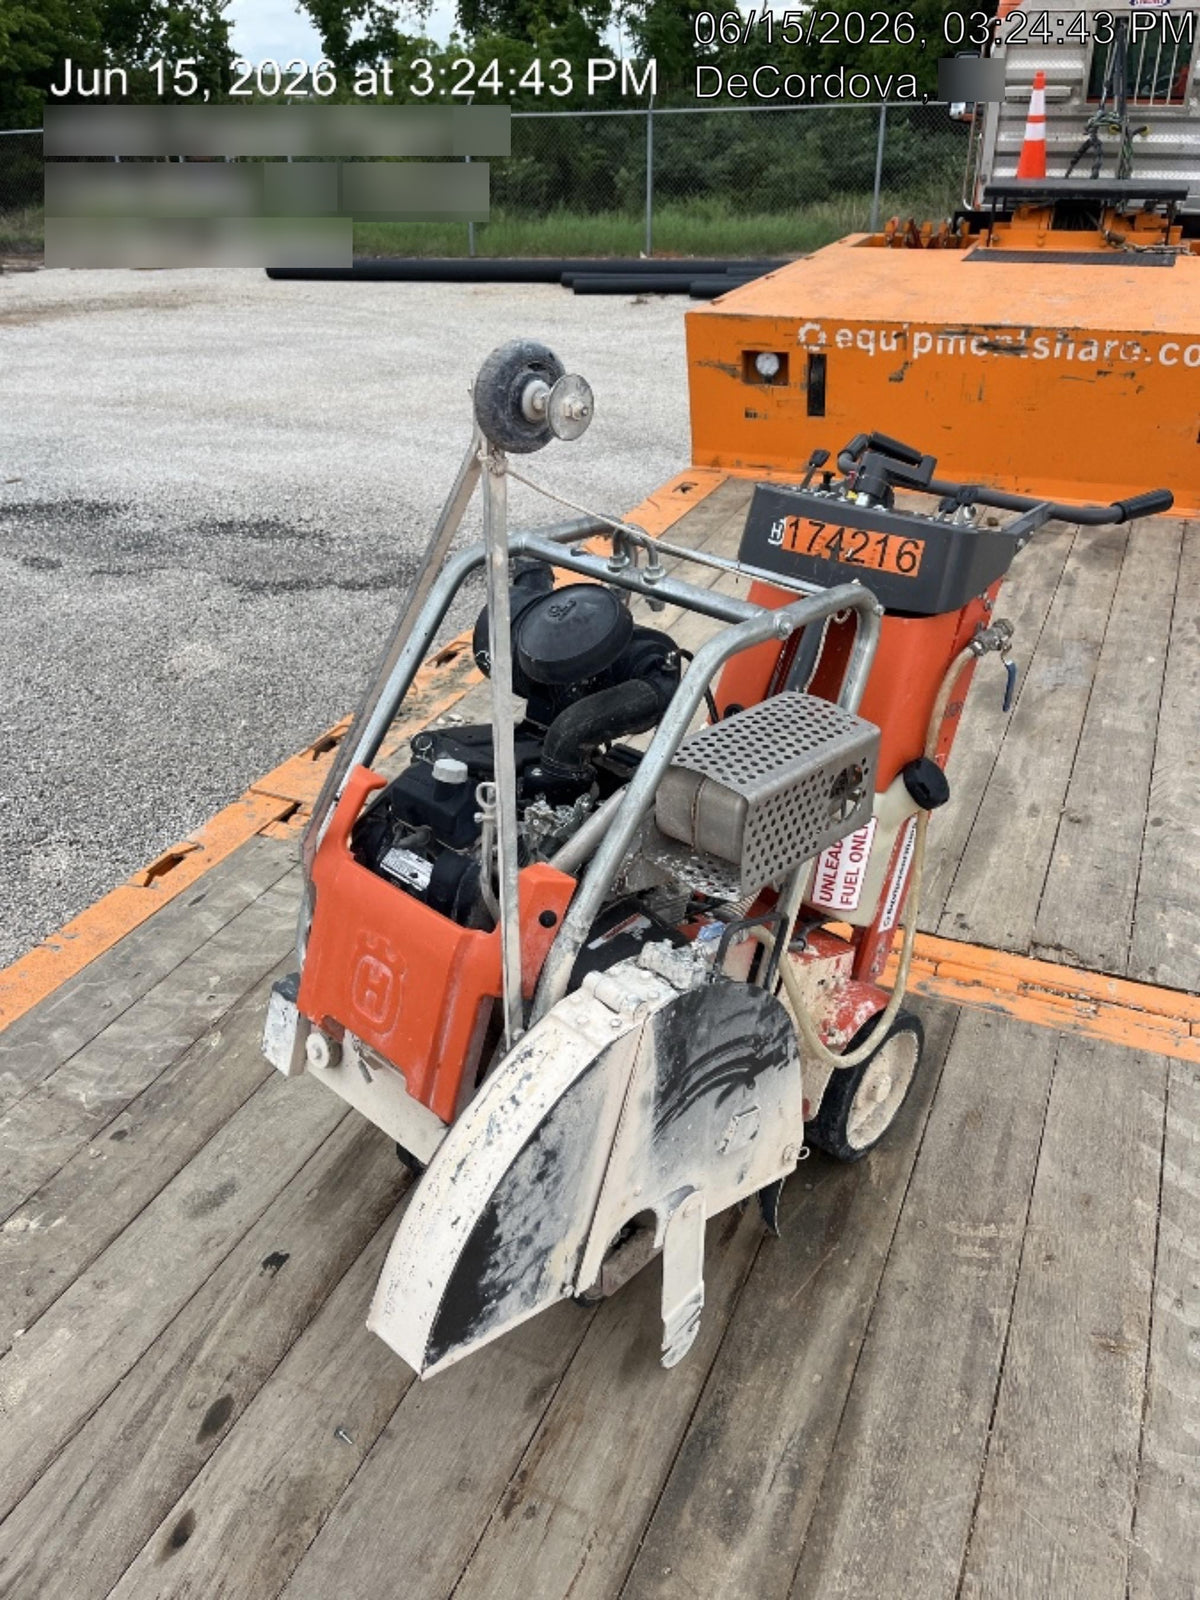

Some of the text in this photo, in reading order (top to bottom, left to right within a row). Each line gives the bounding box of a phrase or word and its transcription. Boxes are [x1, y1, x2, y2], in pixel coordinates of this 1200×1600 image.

[788, 517, 921, 573] 174216
[819, 839, 844, 902] UNLEAD
[841, 868, 861, 905] FUEL
